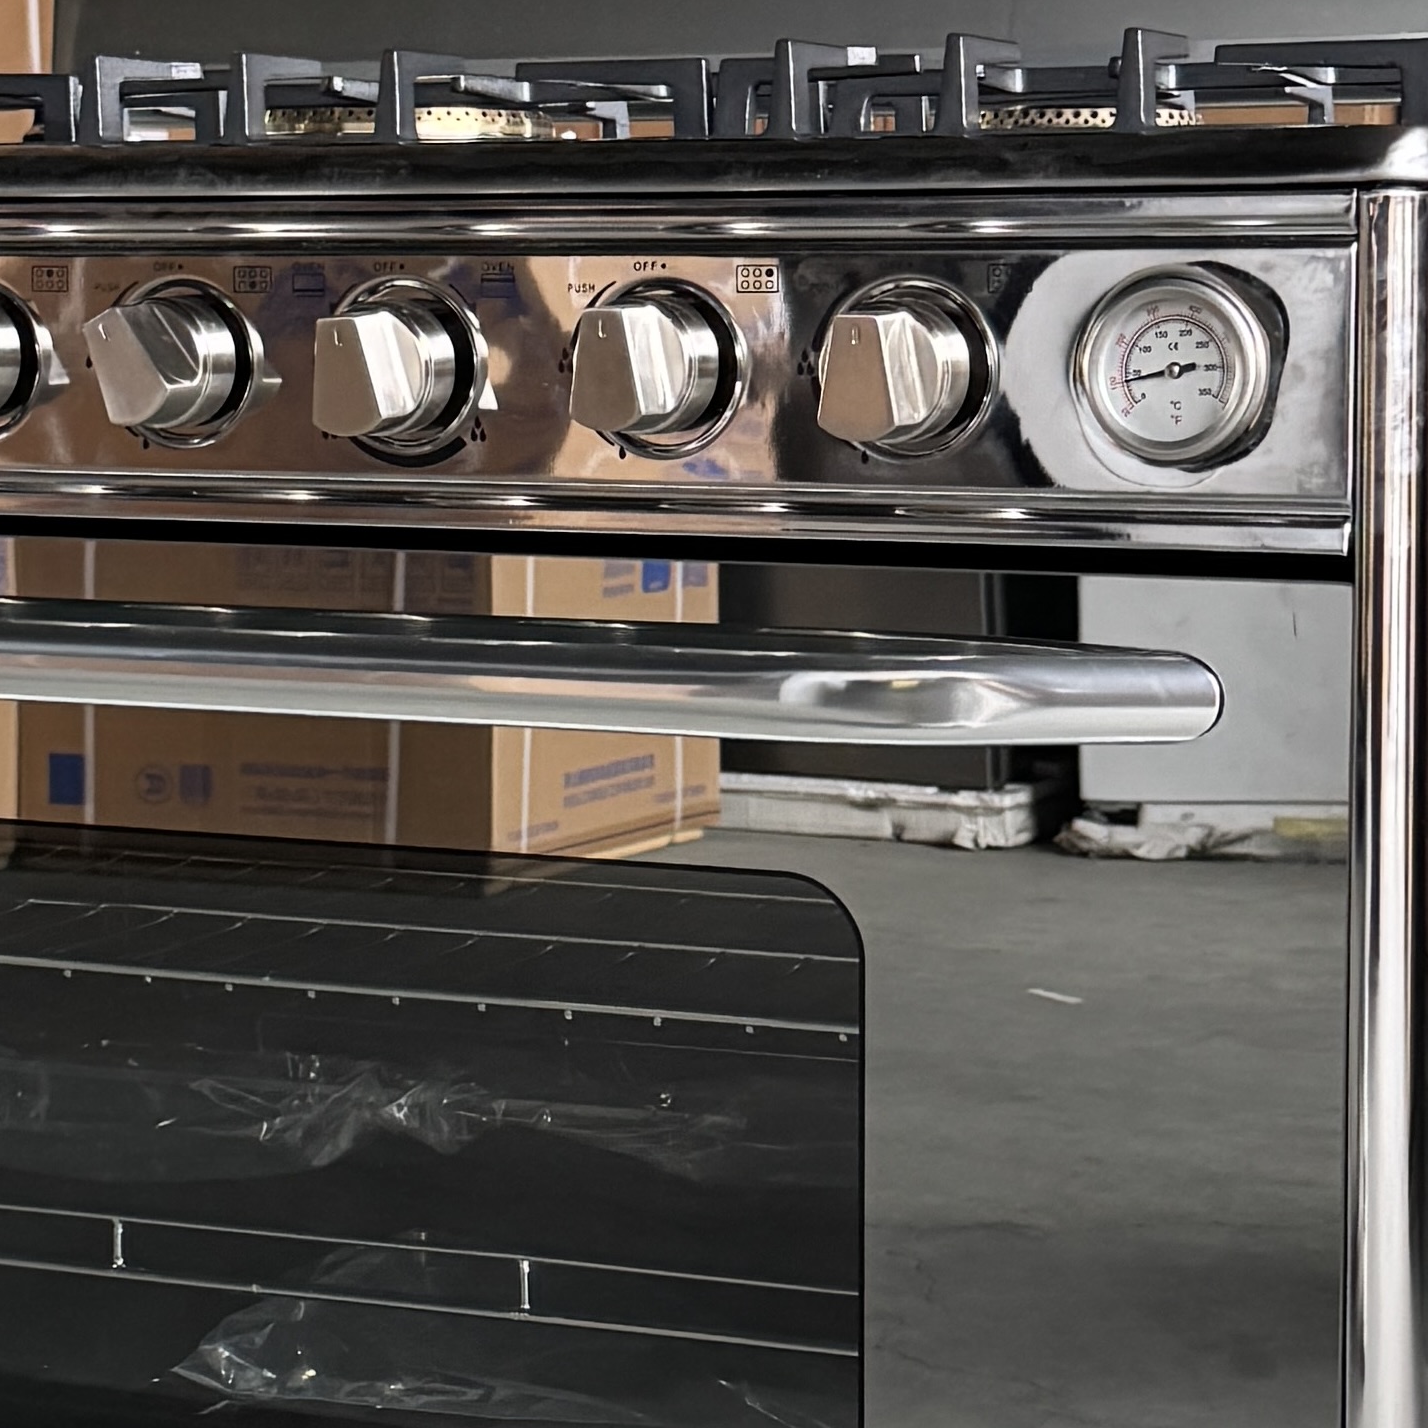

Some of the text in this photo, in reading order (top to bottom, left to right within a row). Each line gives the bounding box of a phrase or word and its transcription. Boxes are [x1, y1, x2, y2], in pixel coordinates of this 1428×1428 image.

[374, 262, 397, 271] OFF
[481, 262, 515, 272] OVEN
[633, 261, 657, 271] OFF
[567, 283, 595, 293] PUSH
